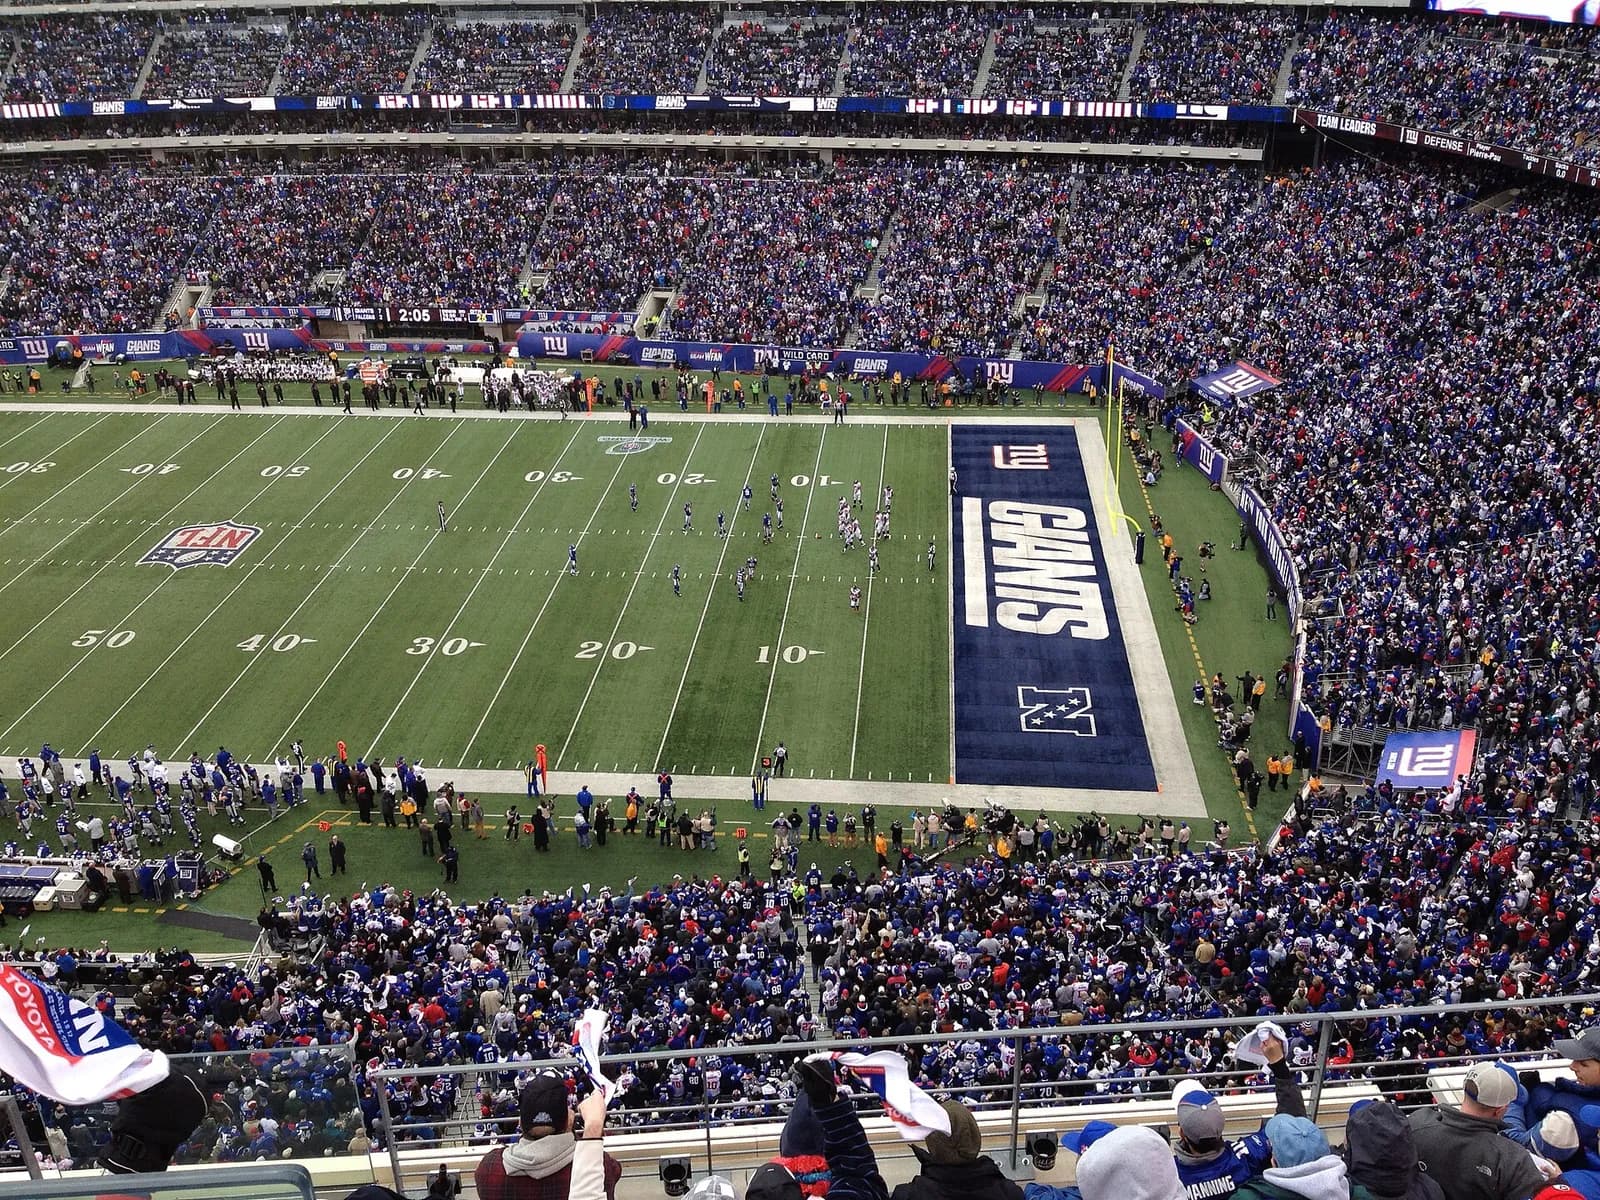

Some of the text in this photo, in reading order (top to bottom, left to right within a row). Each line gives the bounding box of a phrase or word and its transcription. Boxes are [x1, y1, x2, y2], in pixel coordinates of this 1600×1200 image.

[93, 101, 125, 114] GIANTS
[1317, 114, 1376, 135] TEAM LEADERS
[1424, 134, 1463, 151] DEFENSE
[1556, 169, 1566, 178] 0.0
[399, 309, 430, 321] 2:05
[126, 339, 160, 354] GIANTS
[641, 348, 676, 362] GIANTS
[782, 350, 830, 361] WILD CARD
[853, 358, 888, 373] GIANTS
[261, 465, 310, 477] 50
[392, 467, 443, 480] 40
[525, 470, 573, 482] 30
[657, 472, 705, 484] 20
[791, 474, 832, 487] 10
[176, 527, 251, 549] NFL
[988, 500, 1110, 640] GIANTS
[72, 630, 136, 648] 50
[236, 634, 302, 651] 40
[406, 637, 469, 656] 30
[574, 641, 637, 660] 20
[755, 645, 807, 664] 10
[5, 972, 55, 1050] TOYOTA
[1186, 1175, 1236, 1200] MANNING
